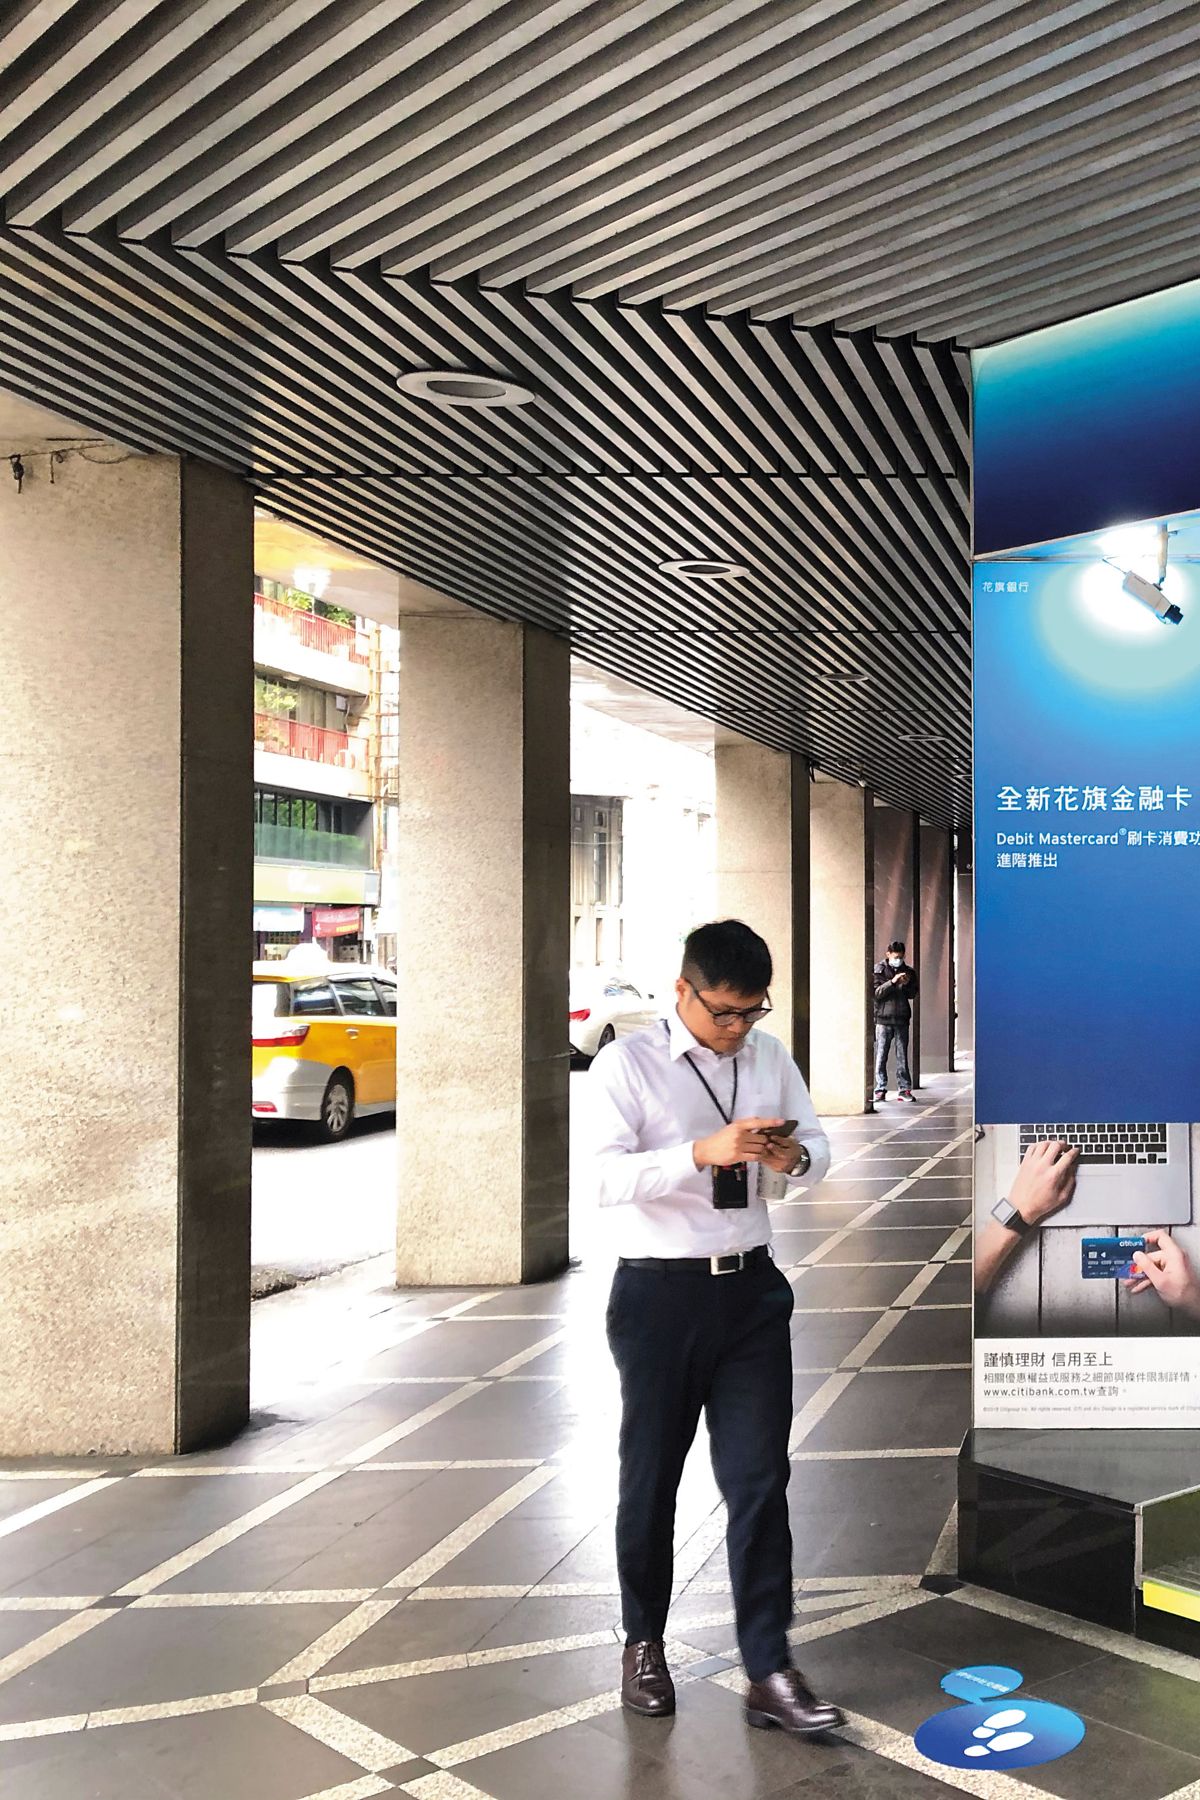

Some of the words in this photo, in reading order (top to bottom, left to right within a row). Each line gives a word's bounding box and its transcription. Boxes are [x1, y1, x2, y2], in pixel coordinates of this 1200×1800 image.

[982, 582, 1029, 592] 花旗銀行
[997, 785, 1192, 812] 全新花旗金融卡
[997, 832, 1033, 845] Debit
[997, 852, 1057, 868] 進階推出
[983, 1351, 1045, 1368] 謹慎理財
[1052, 1351, 1114, 1368] 信用至上
